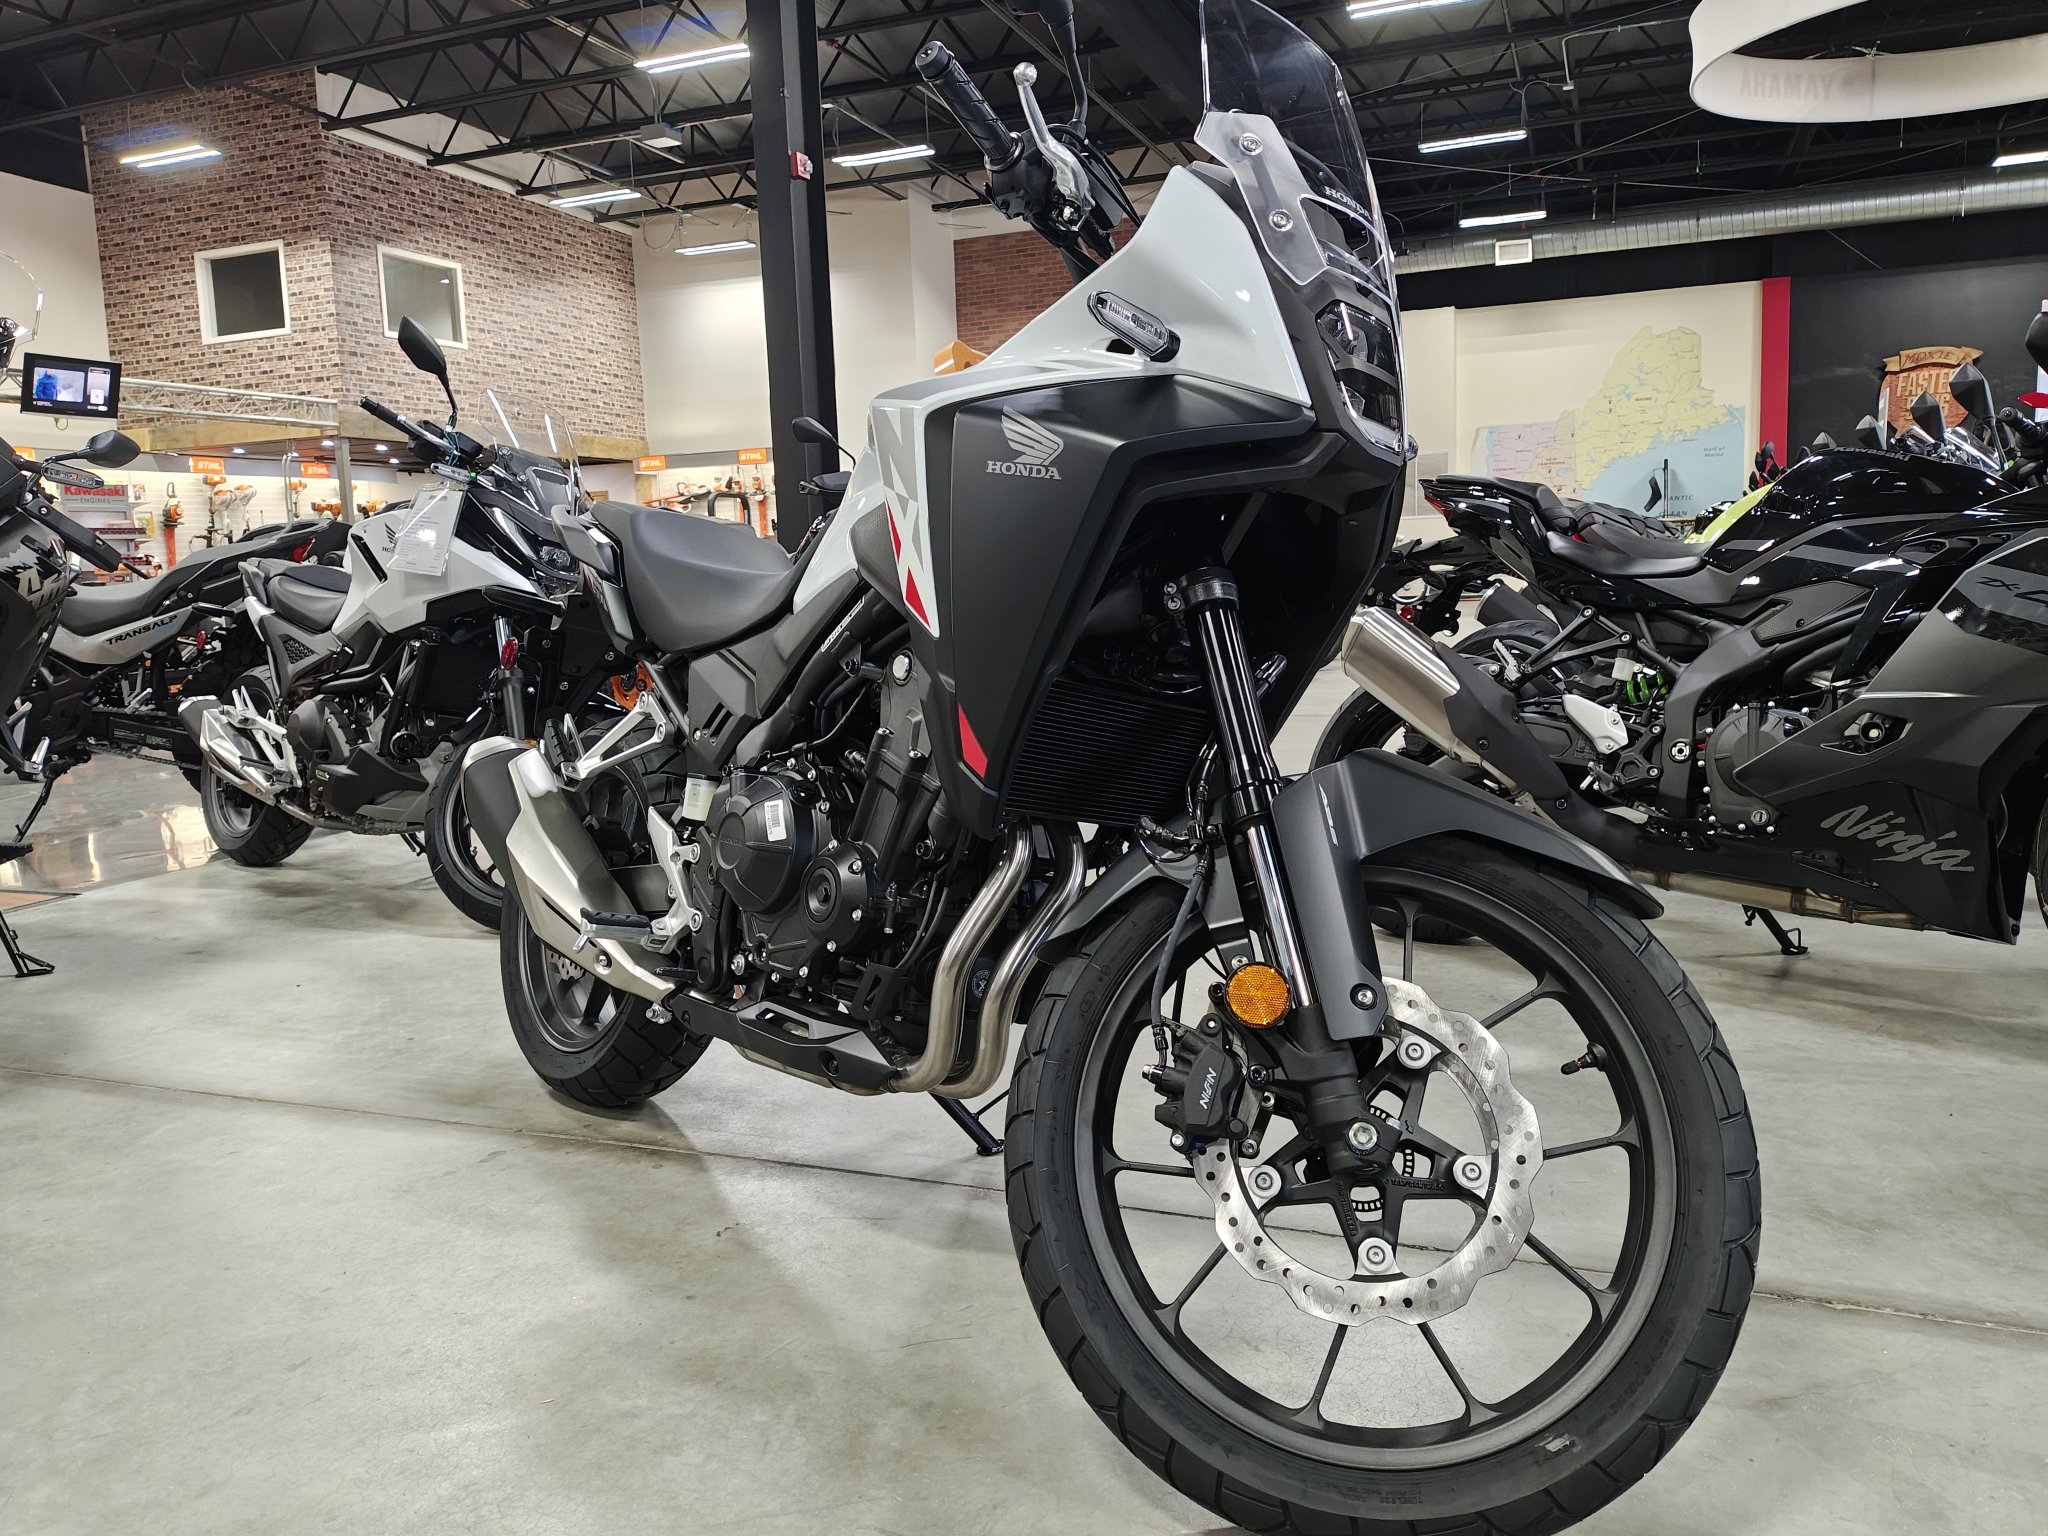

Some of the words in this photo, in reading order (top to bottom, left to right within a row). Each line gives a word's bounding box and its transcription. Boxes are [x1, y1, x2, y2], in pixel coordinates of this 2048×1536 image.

[1324, 186, 1372, 221] HONDA
[1834, 446, 1912, 461] Kawasaki
[197, 461, 222, 470] STIHL
[306, 466, 329, 475] STIHL
[640, 459, 662, 468] STIHL
[985, 460, 1062, 480] HONDA
[64, 485, 125, 496] Kawasaki
[106, 615, 177, 645] TRANSALP
[1821, 805, 1975, 872] Ninja
[1200, 1067, 1216, 1109] NISSIN
